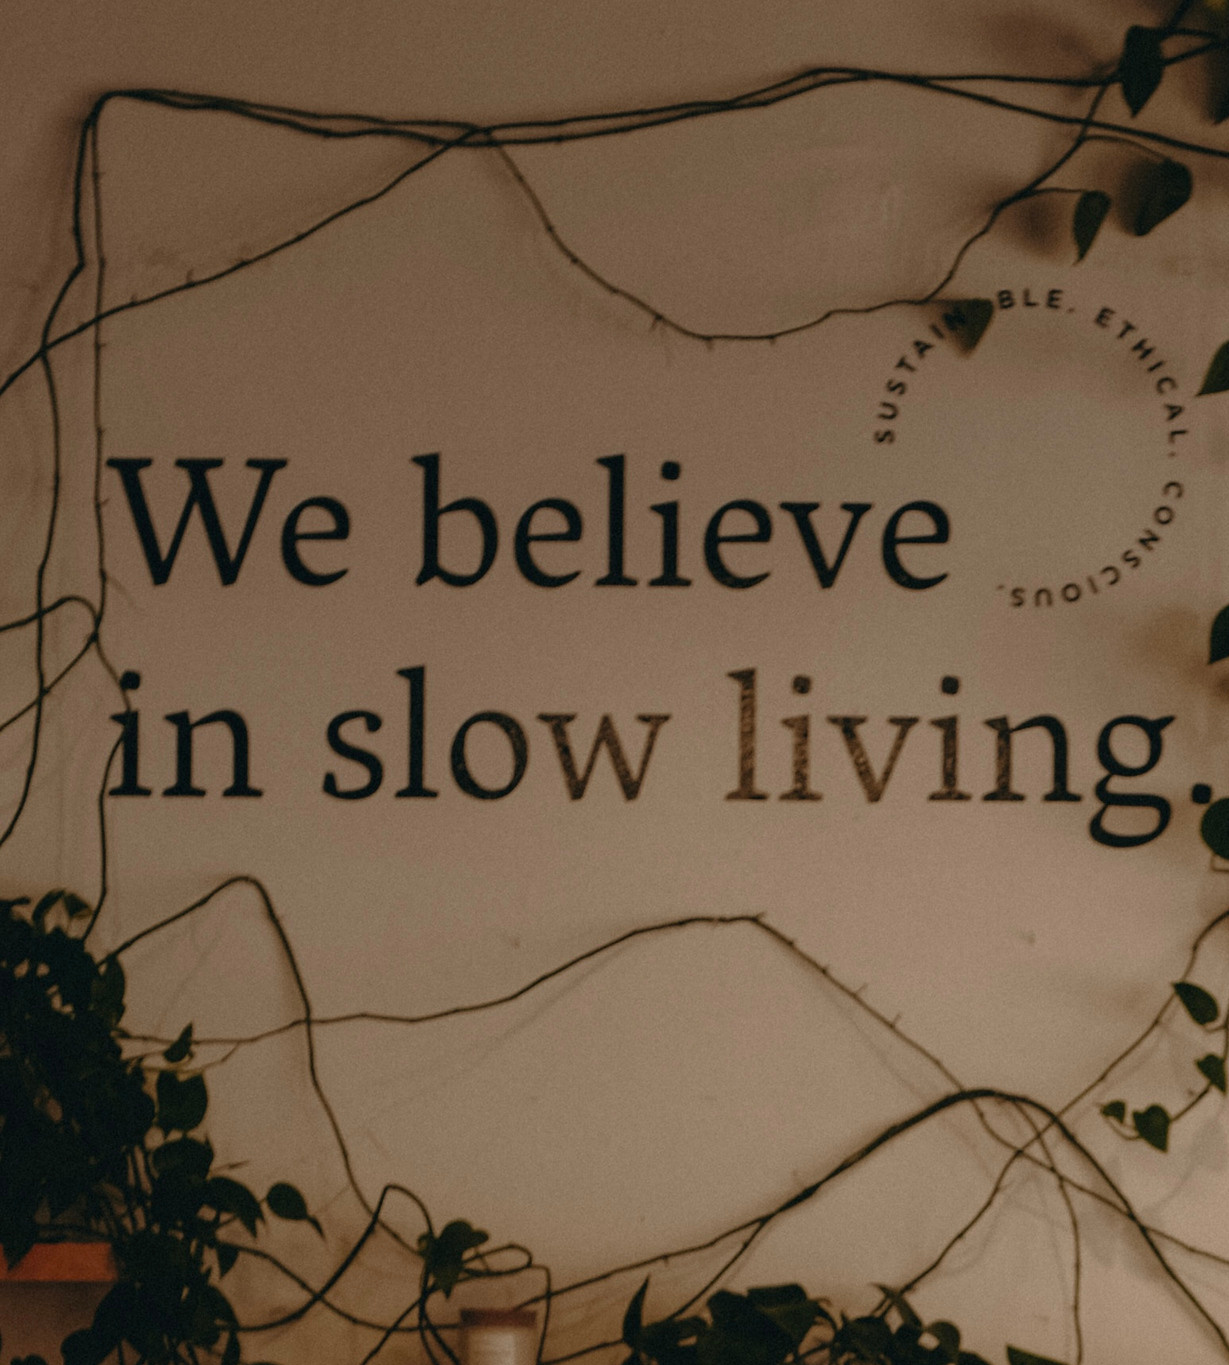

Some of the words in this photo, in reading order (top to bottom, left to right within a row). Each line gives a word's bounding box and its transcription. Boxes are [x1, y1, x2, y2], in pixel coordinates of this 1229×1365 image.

[1093, 306, 1189, 457] ETHICAL.
[106, 457, 351, 587] We
[410, 452, 952, 590] believe
[108, 670, 264, 798] in
[322, 665, 671, 801] slow
[725, 667, 1213, 848] living.
